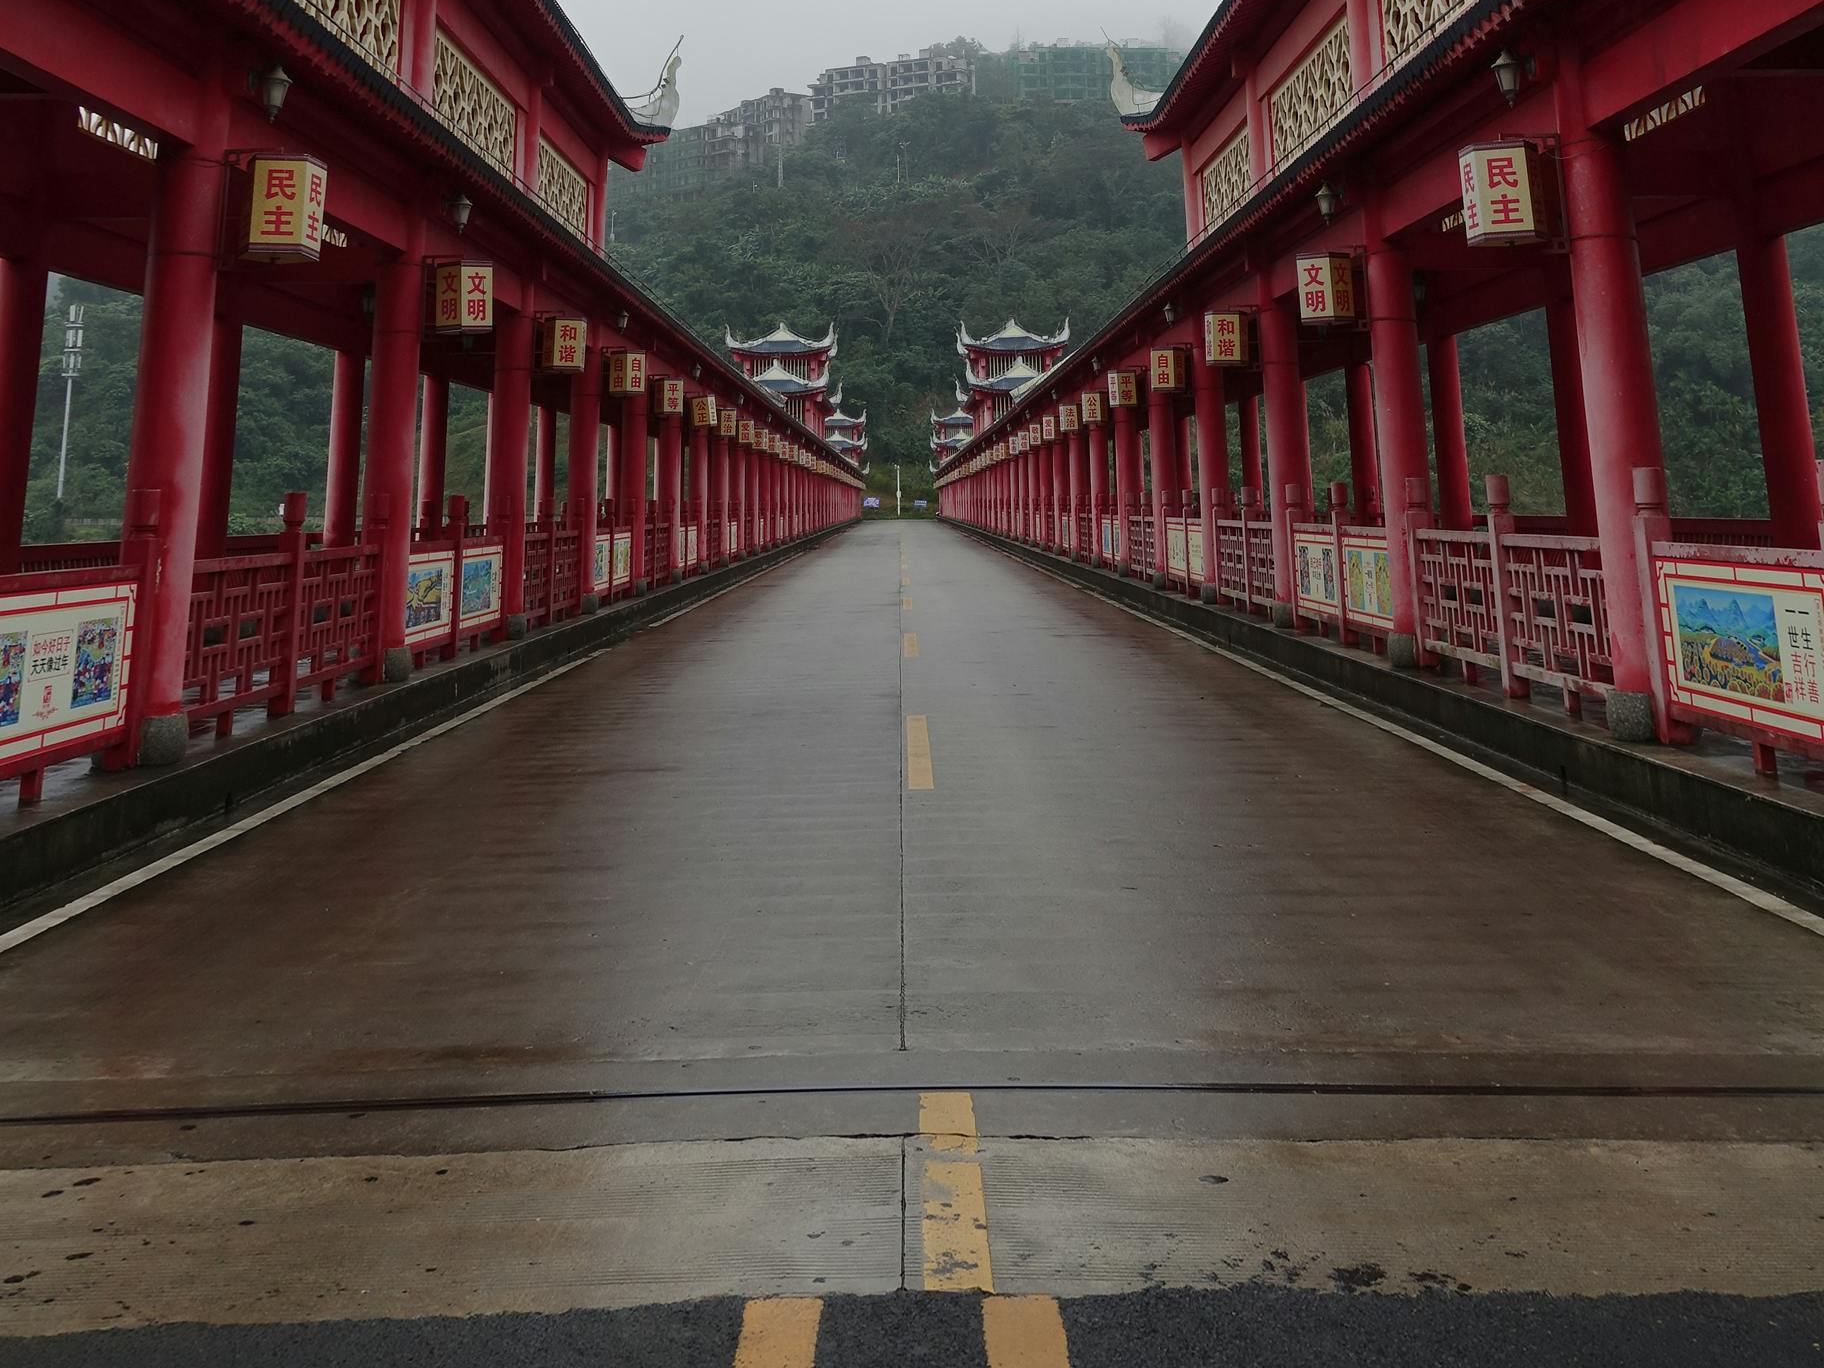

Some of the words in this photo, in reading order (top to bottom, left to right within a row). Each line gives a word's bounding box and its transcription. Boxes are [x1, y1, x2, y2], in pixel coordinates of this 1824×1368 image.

[260, 169, 296, 235] 民主
[306, 174, 322, 242] 民主
[1464, 163, 1479, 230] 民主
[1486, 157, 1524, 224] 民主
[441, 272, 458, 320] 文明
[467, 272, 487, 320] 文明
[1304, 264, 1326, 312] 文明
[1334, 264, 1350, 311] 文明
[559, 325, 577, 363] 和谐
[1218, 319, 1235, 356] 和谐
[614, 359, 623, 388] 自由
[632, 357, 641, 388] 自由
[1158, 354, 1169, 384] 自由
[667, 384, 679, 410] 平等
[1087, 396, 1097, 419] 公正
[1121, 376, 1133, 402] 平等
[696, 400, 707, 423] 公正
[723, 413, 733, 434] 法治
[1066, 408, 1075, 428] 法治
[33, 636, 71, 657] 如今好日子
[1785, 608, 1806, 701] 一世吉祥
[1798, 611, 1820, 704] 一生行善
[30, 655, 70, 676] 天天像过年
